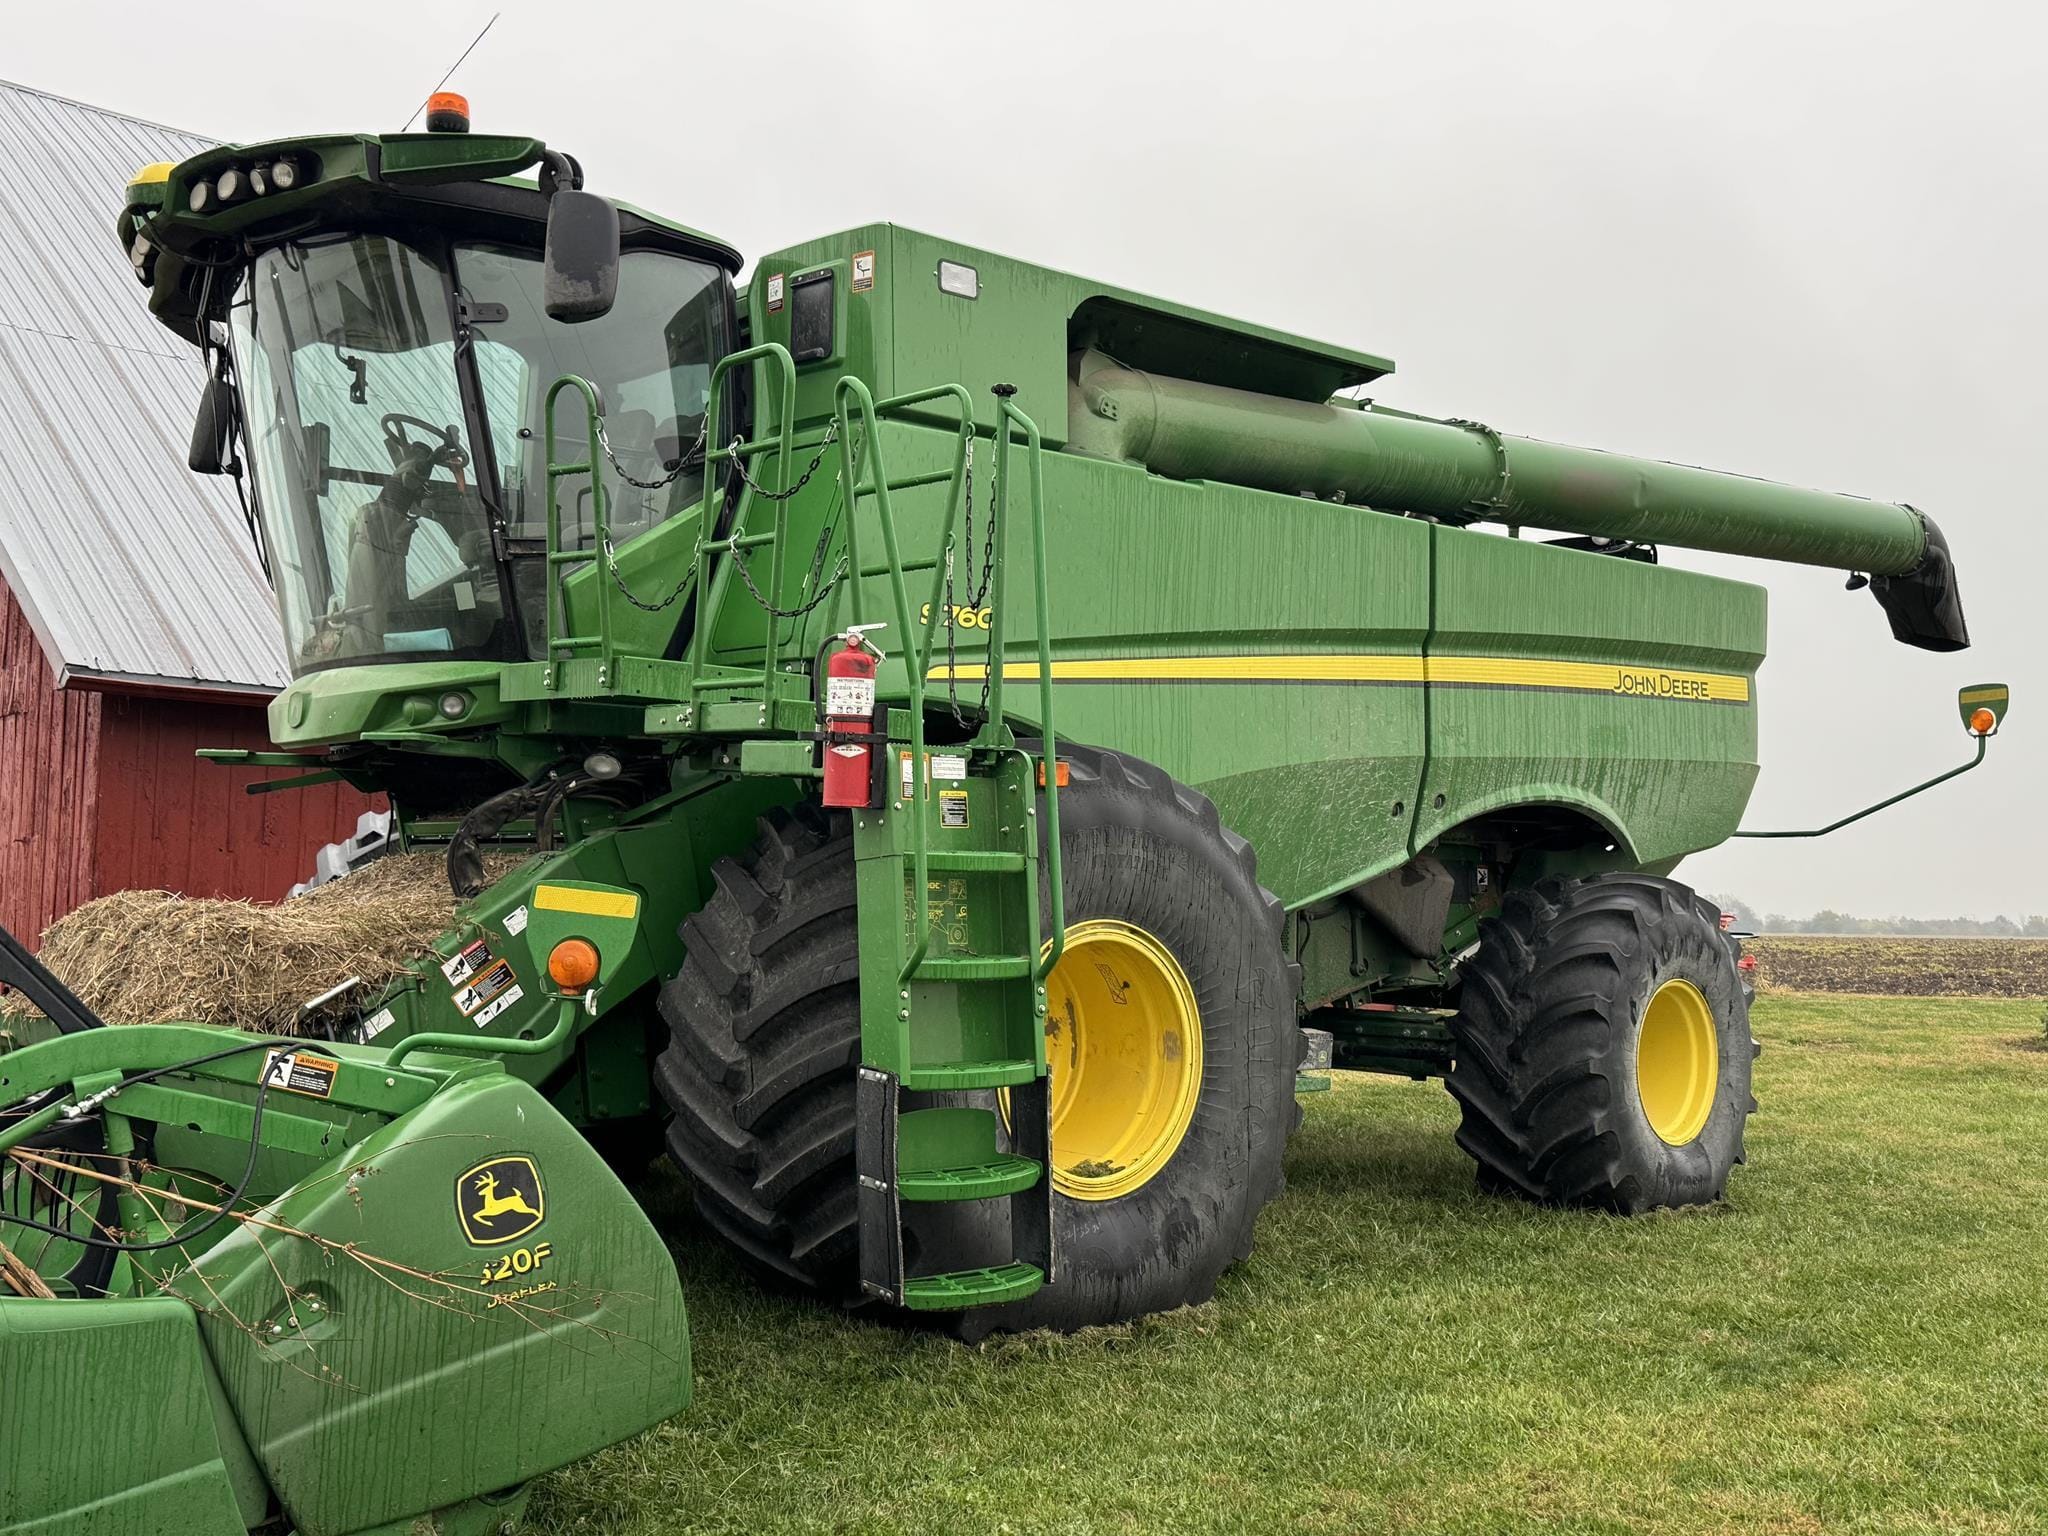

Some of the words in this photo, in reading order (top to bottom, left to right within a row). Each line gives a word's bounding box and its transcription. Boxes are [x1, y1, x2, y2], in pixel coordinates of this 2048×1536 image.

[1613, 669, 1656, 693] JOHN
[1659, 674, 1709, 698] DEERE
[303, 1057, 334, 1069] WARNING
